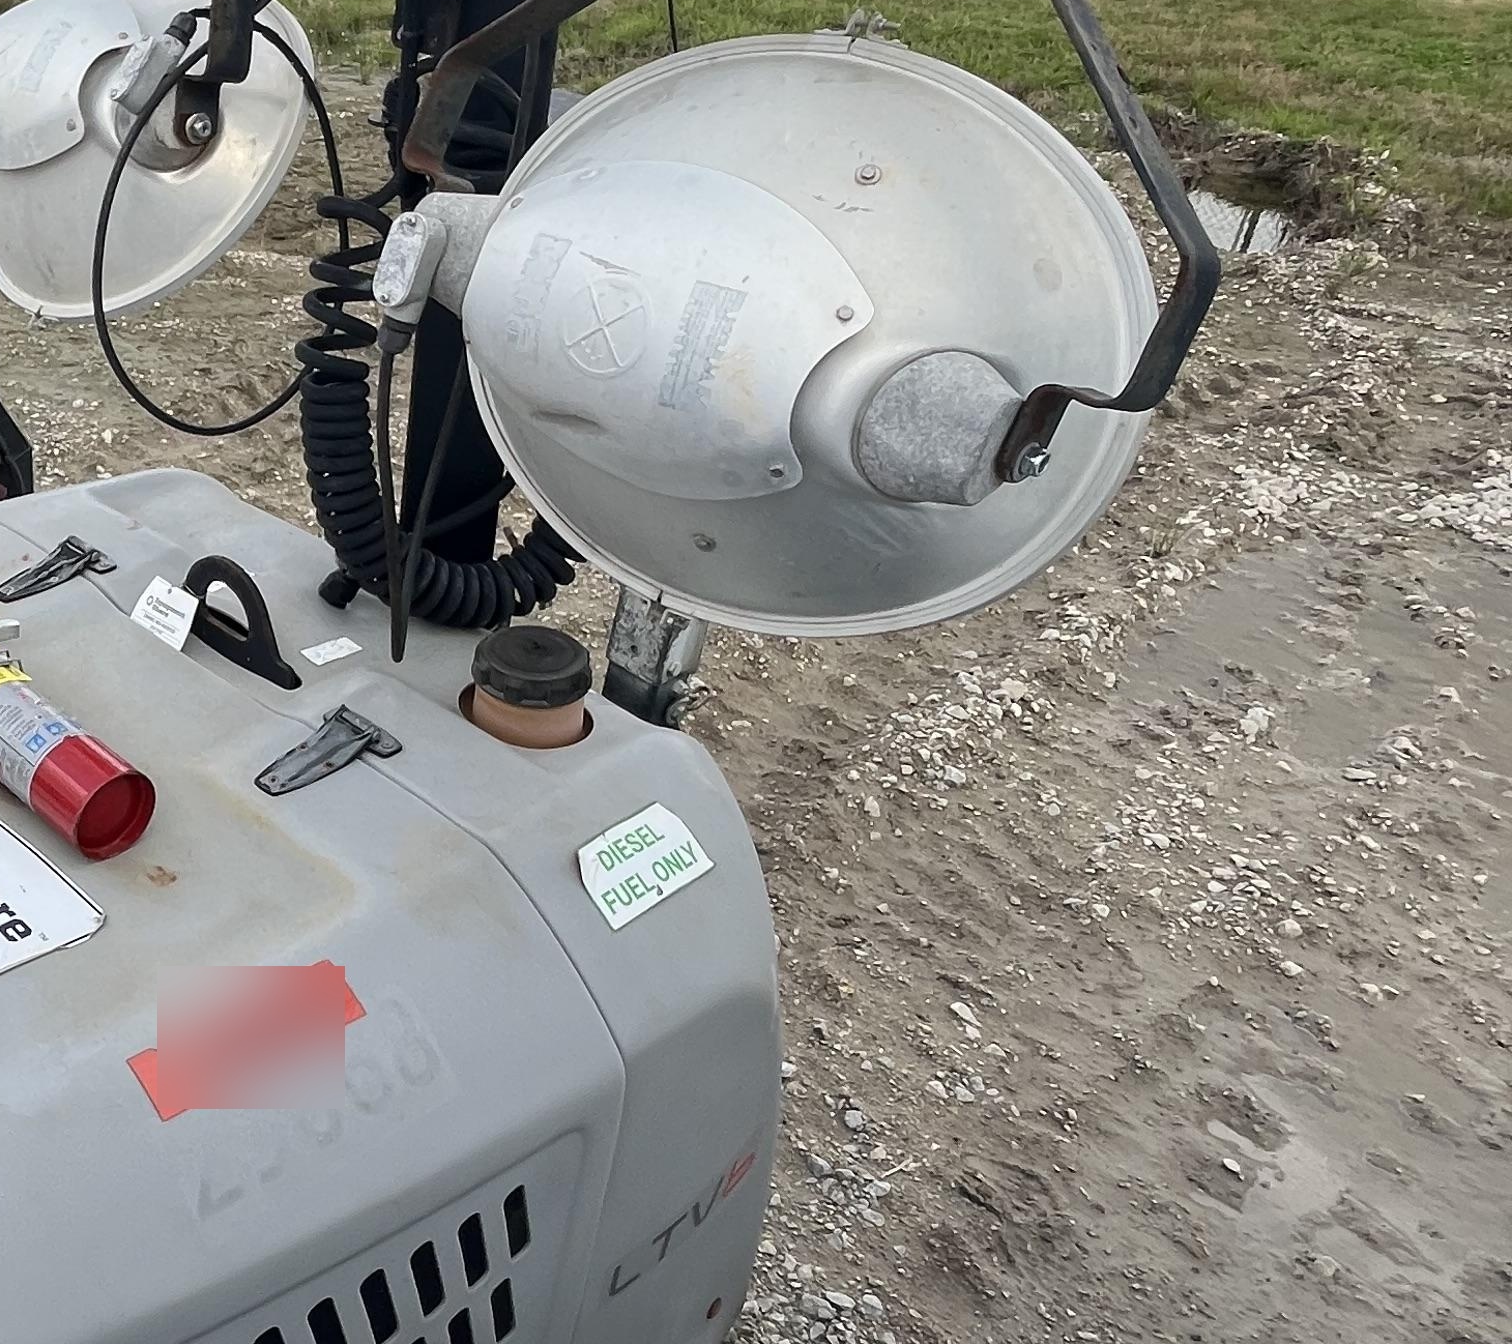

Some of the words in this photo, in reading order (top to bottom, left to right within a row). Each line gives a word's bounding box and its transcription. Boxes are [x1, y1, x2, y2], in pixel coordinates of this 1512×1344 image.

[596, 823, 666, 872] DIESEL
[601, 872, 656, 915] FUEL
[651, 840, 698, 882] ONLY
